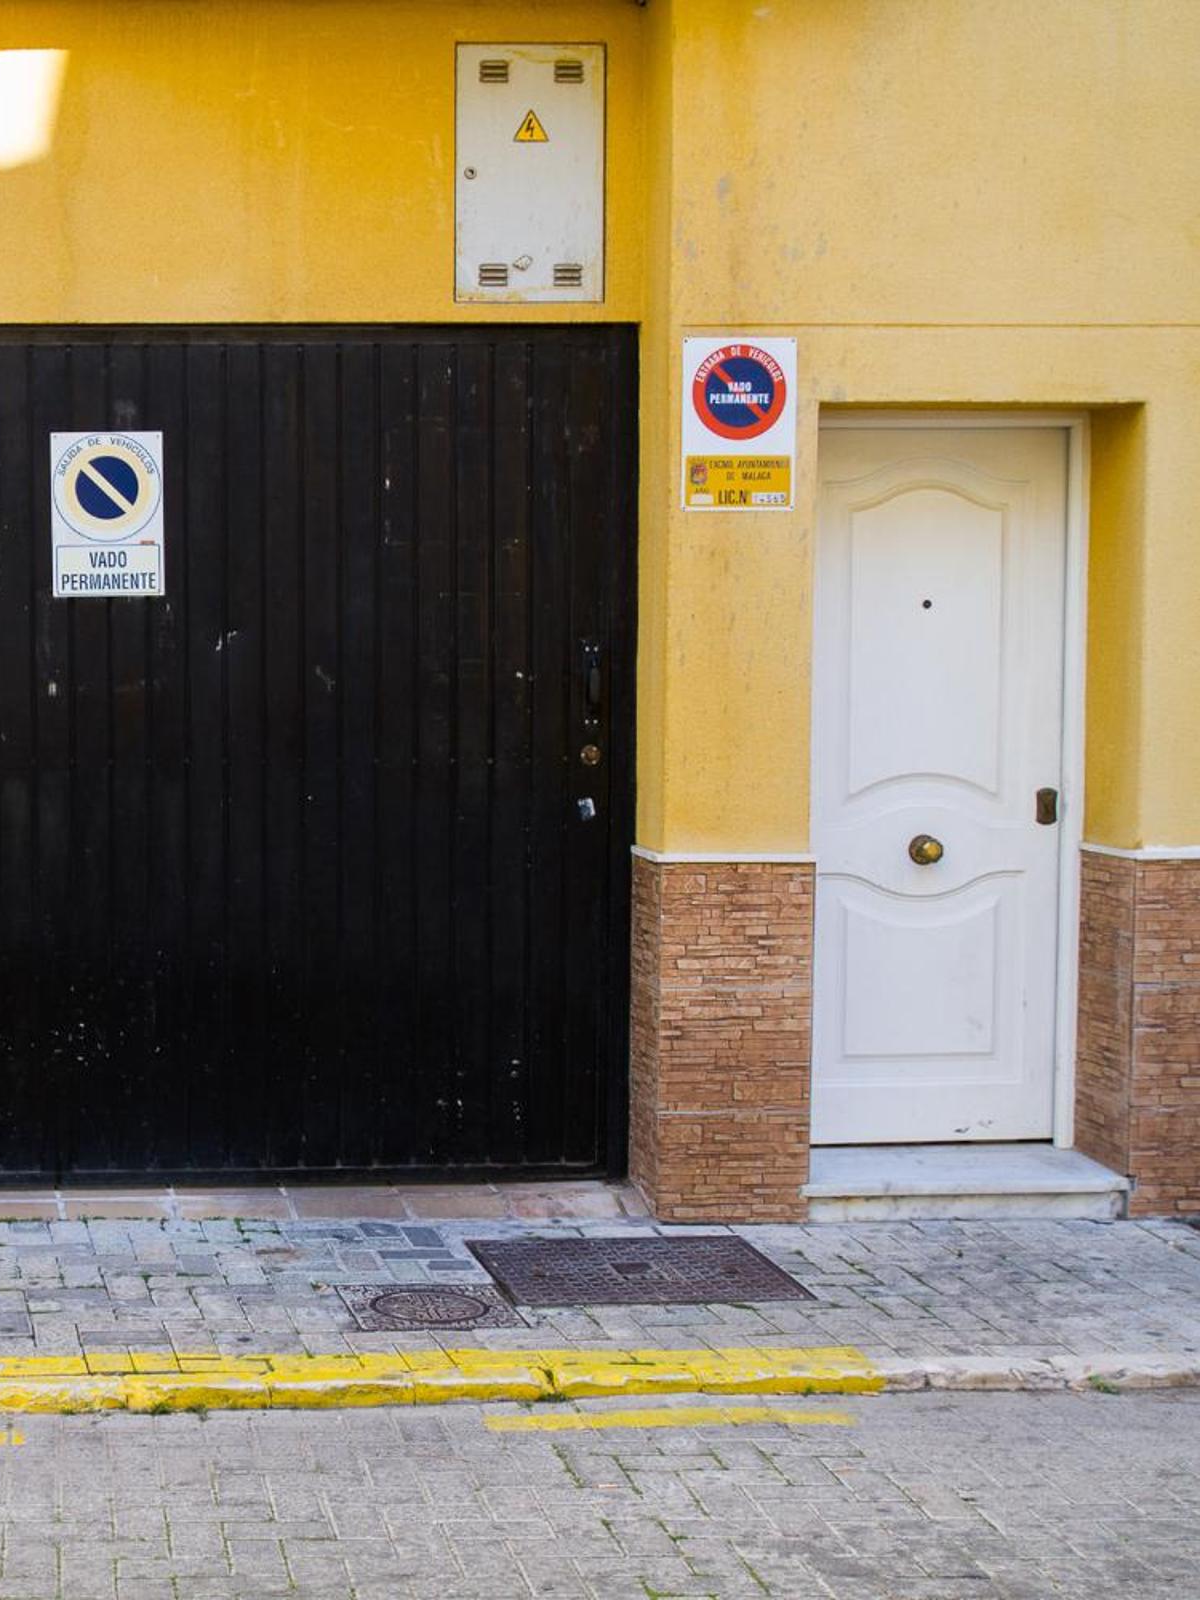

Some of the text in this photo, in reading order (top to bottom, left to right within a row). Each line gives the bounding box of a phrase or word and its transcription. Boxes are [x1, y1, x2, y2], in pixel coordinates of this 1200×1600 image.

[731, 346, 741, 357] DE
[727, 382, 752, 393] VADO
[709, 393, 769, 405] PERMANENTE
[58, 436, 155, 476] SALIDA DE VEHICULOS
[89, 551, 128, 569] VADO
[61, 572, 157, 591] PERMANENTE
